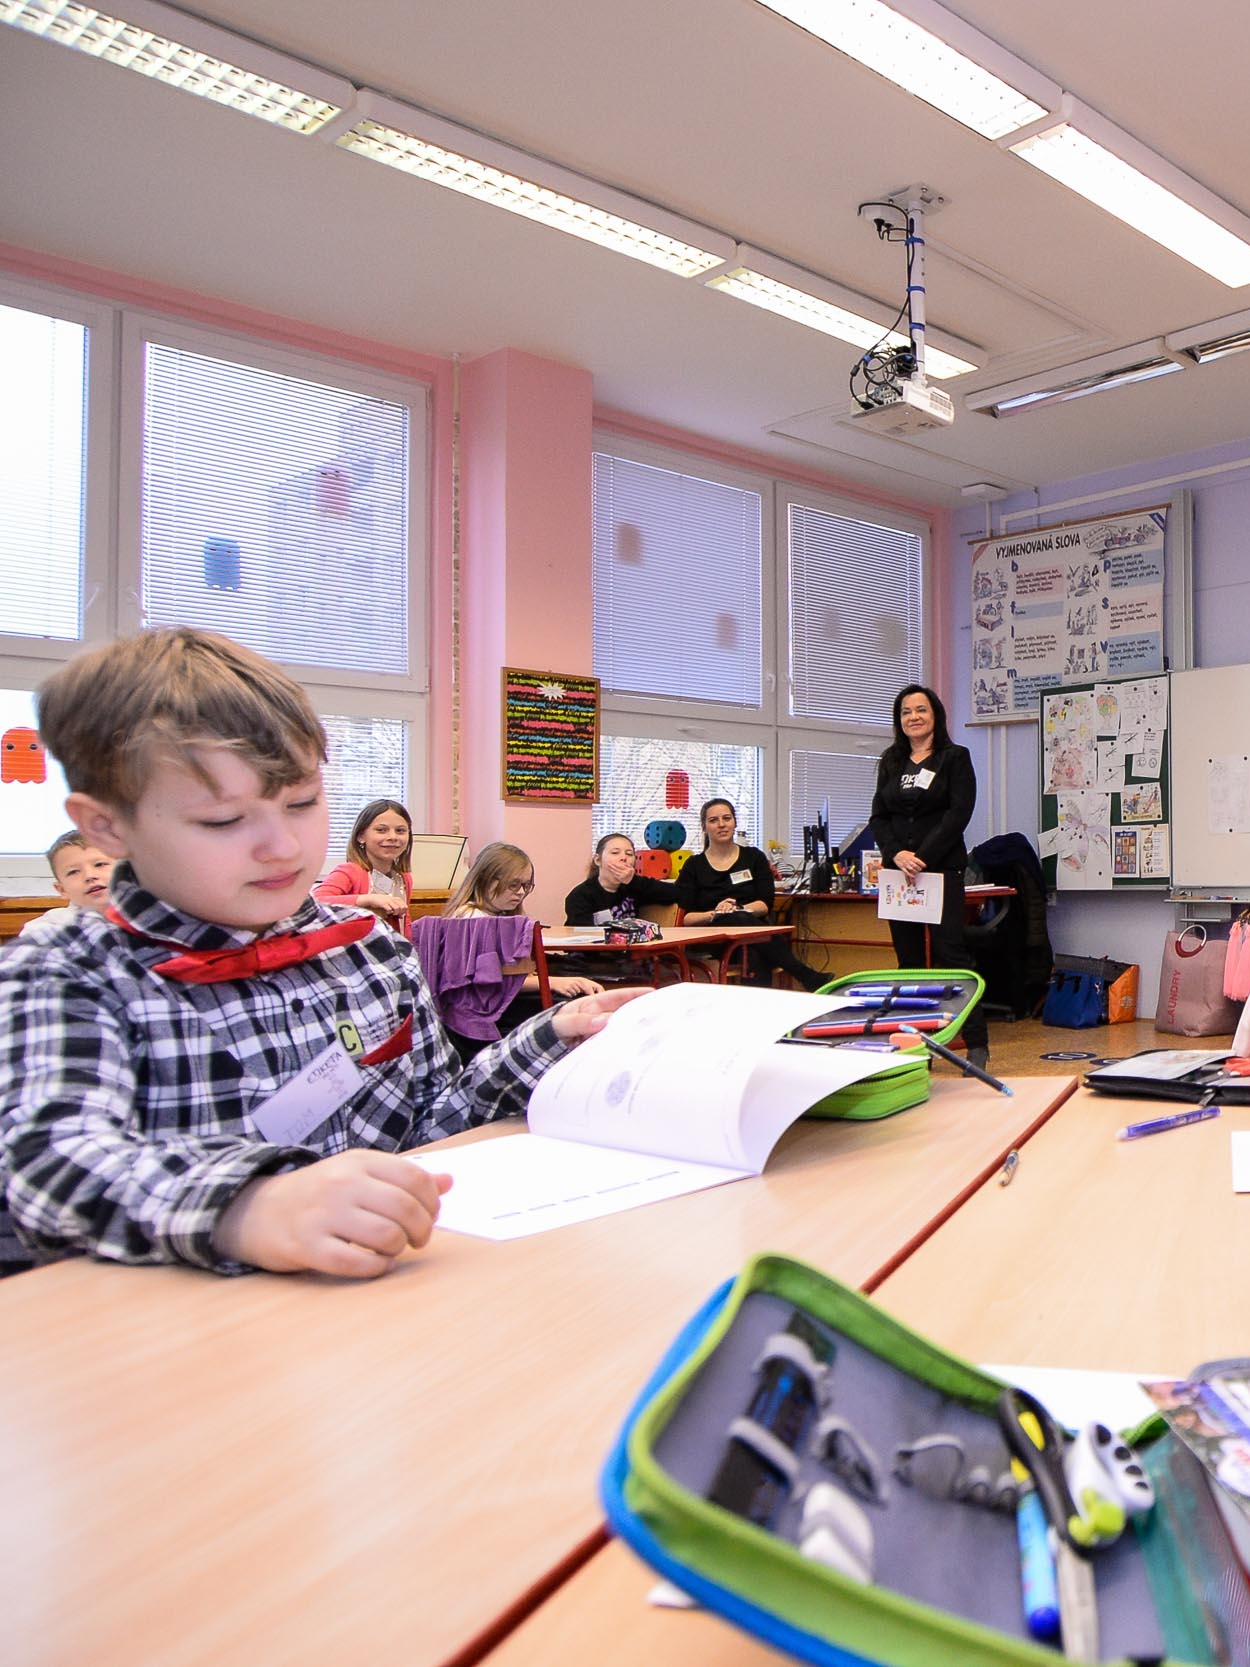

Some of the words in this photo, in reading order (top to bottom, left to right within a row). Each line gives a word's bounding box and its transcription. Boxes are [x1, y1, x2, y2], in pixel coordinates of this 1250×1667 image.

[996, 534, 1053, 559] VYJMENOVANÁ
[1055, 532, 1081, 550] SLOVA
[1011, 559, 1019, 572] b
[1104, 560, 1111, 573] p
[1007, 669, 1017, 678] m
[1168, 969, 1182, 1025] LAUNDRY
[306, 1051, 343, 1084] ETIKETA
